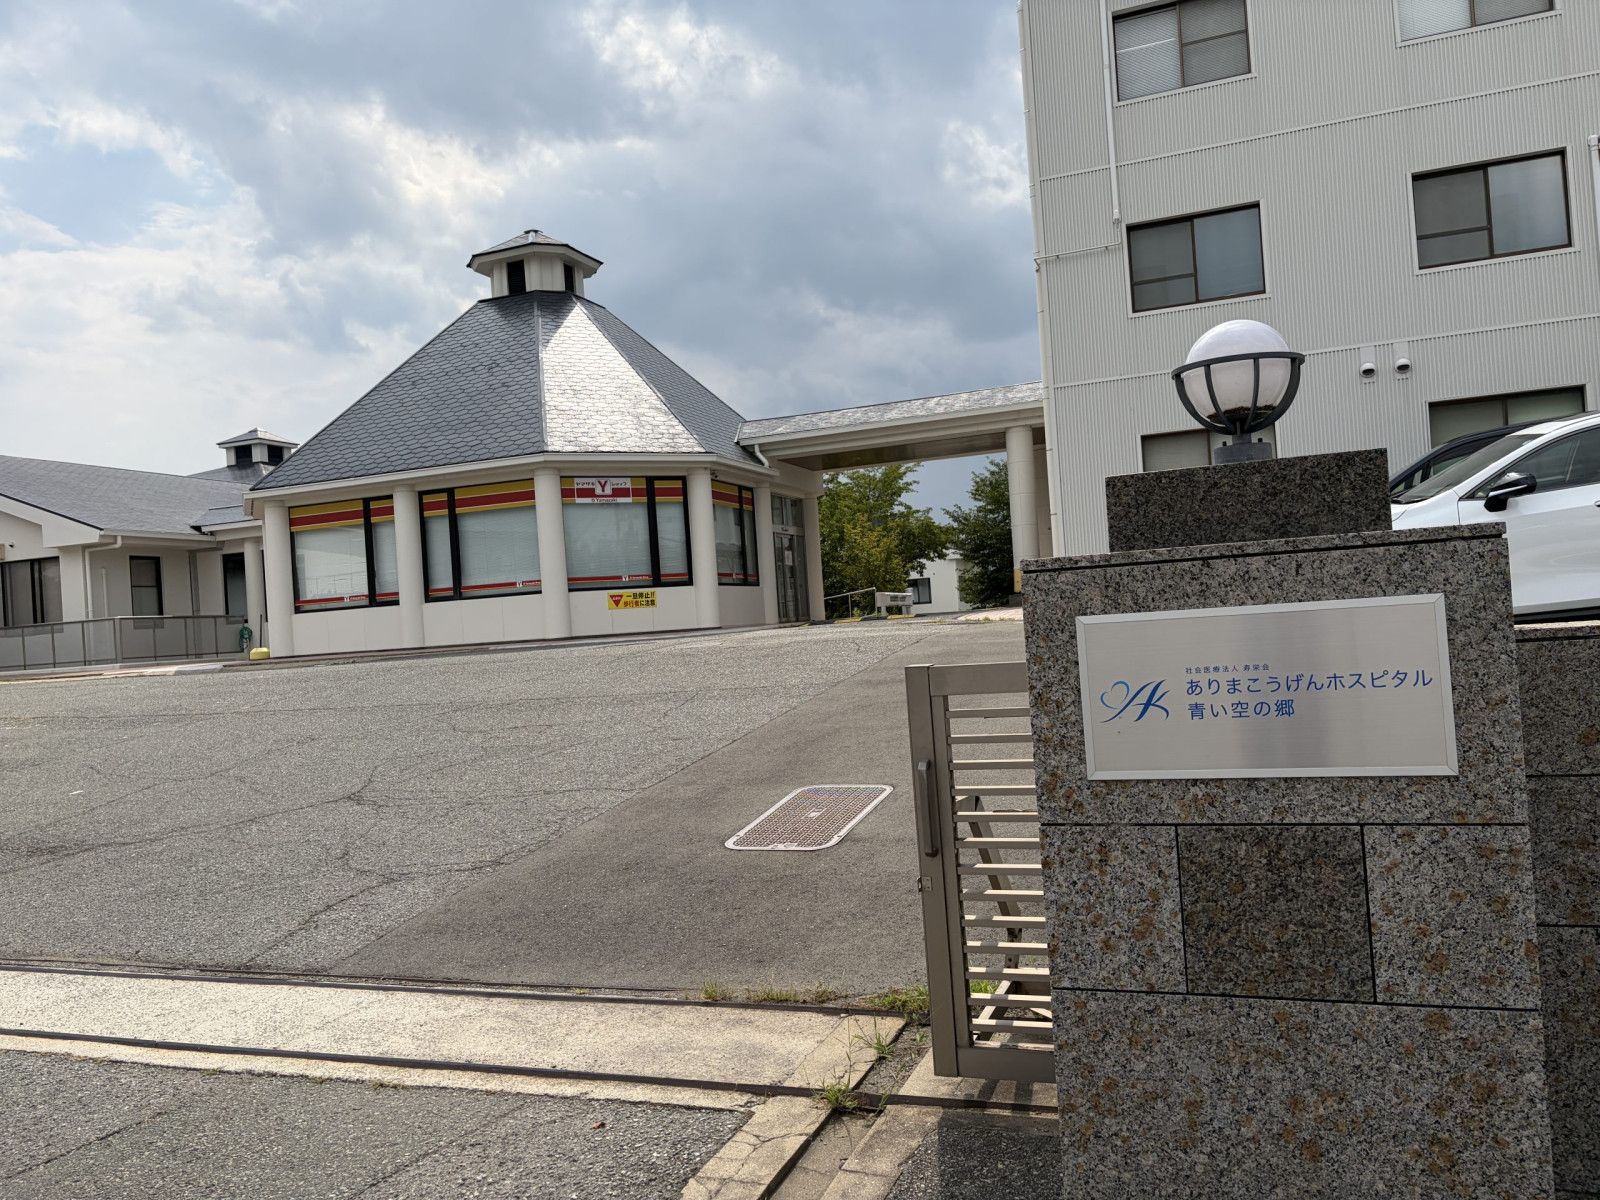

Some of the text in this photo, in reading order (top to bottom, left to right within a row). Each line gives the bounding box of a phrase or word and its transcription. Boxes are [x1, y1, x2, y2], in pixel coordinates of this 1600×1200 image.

[597, 480, 609, 493] Y
[623, 599, 656, 608] 歩行者に注意
[1185, 663, 1270, 674] 社会医療法人 寿栄会
[1186, 669, 1433, 696] ありまこうげんホスピタル
[1188, 699, 1295, 720] 青い空の郷
